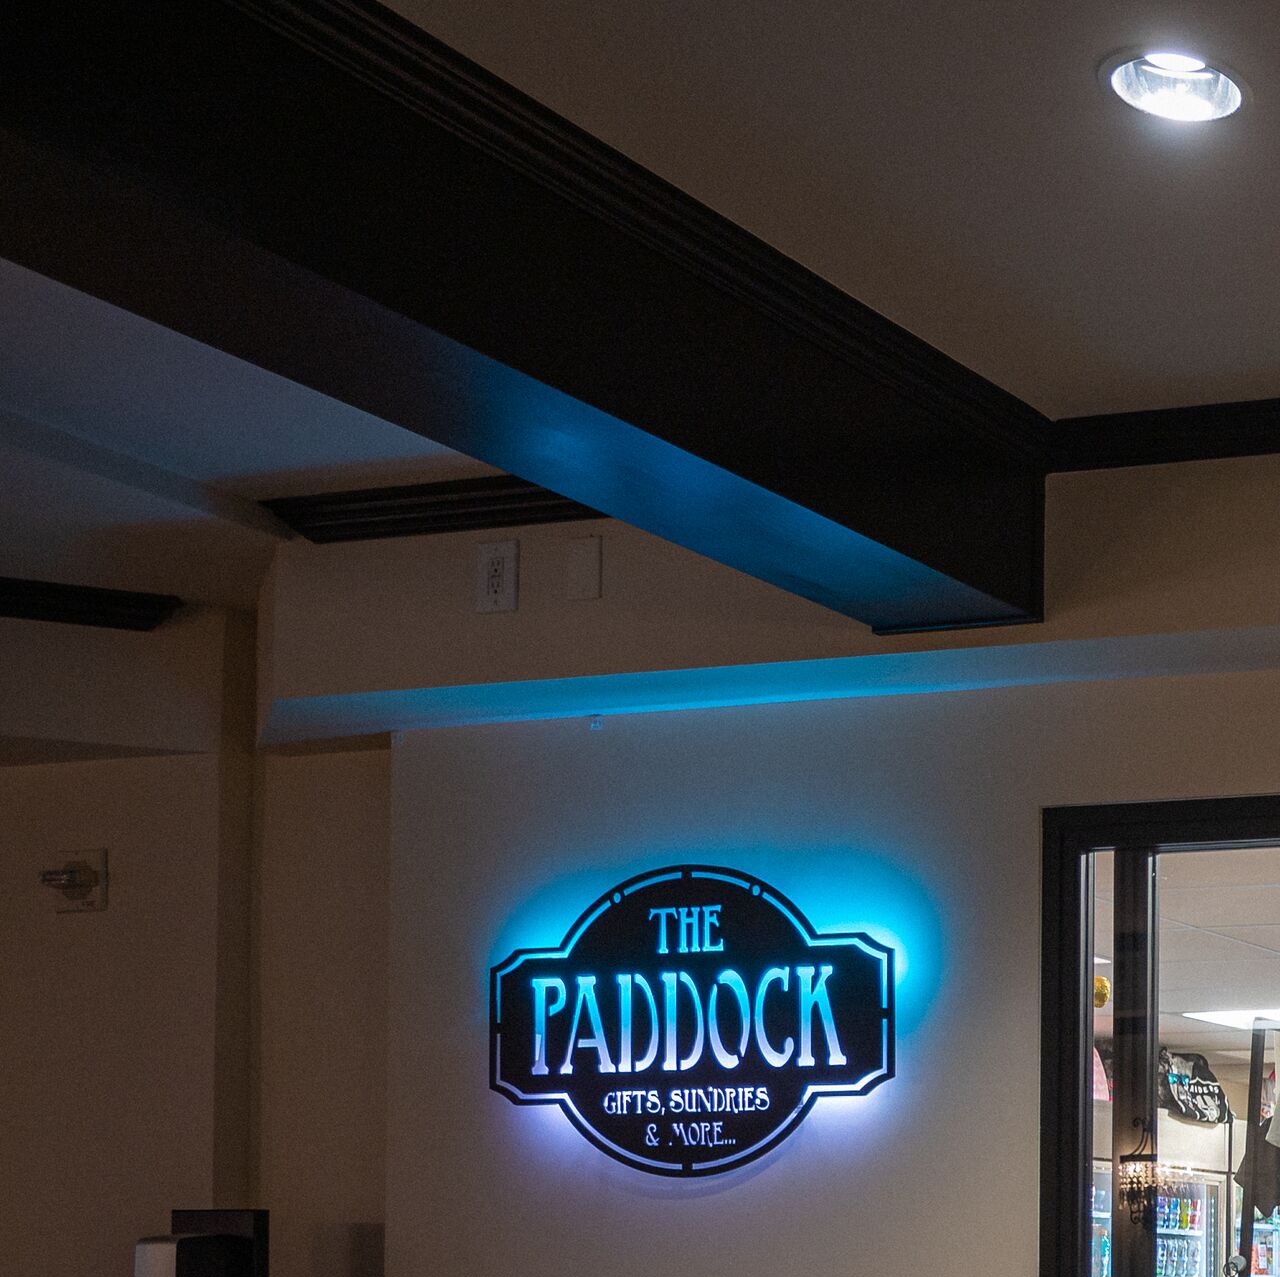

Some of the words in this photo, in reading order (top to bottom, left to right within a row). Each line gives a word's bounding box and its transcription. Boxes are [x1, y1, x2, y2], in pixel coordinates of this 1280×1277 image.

[648, 904, 724, 954] THE
[530, 965, 847, 1076] PADDOCK
[603, 1088, 667, 1116] GIFTS,
[669, 1086, 771, 1114] SUNDRIES
[645, 1124, 660, 1147] &
